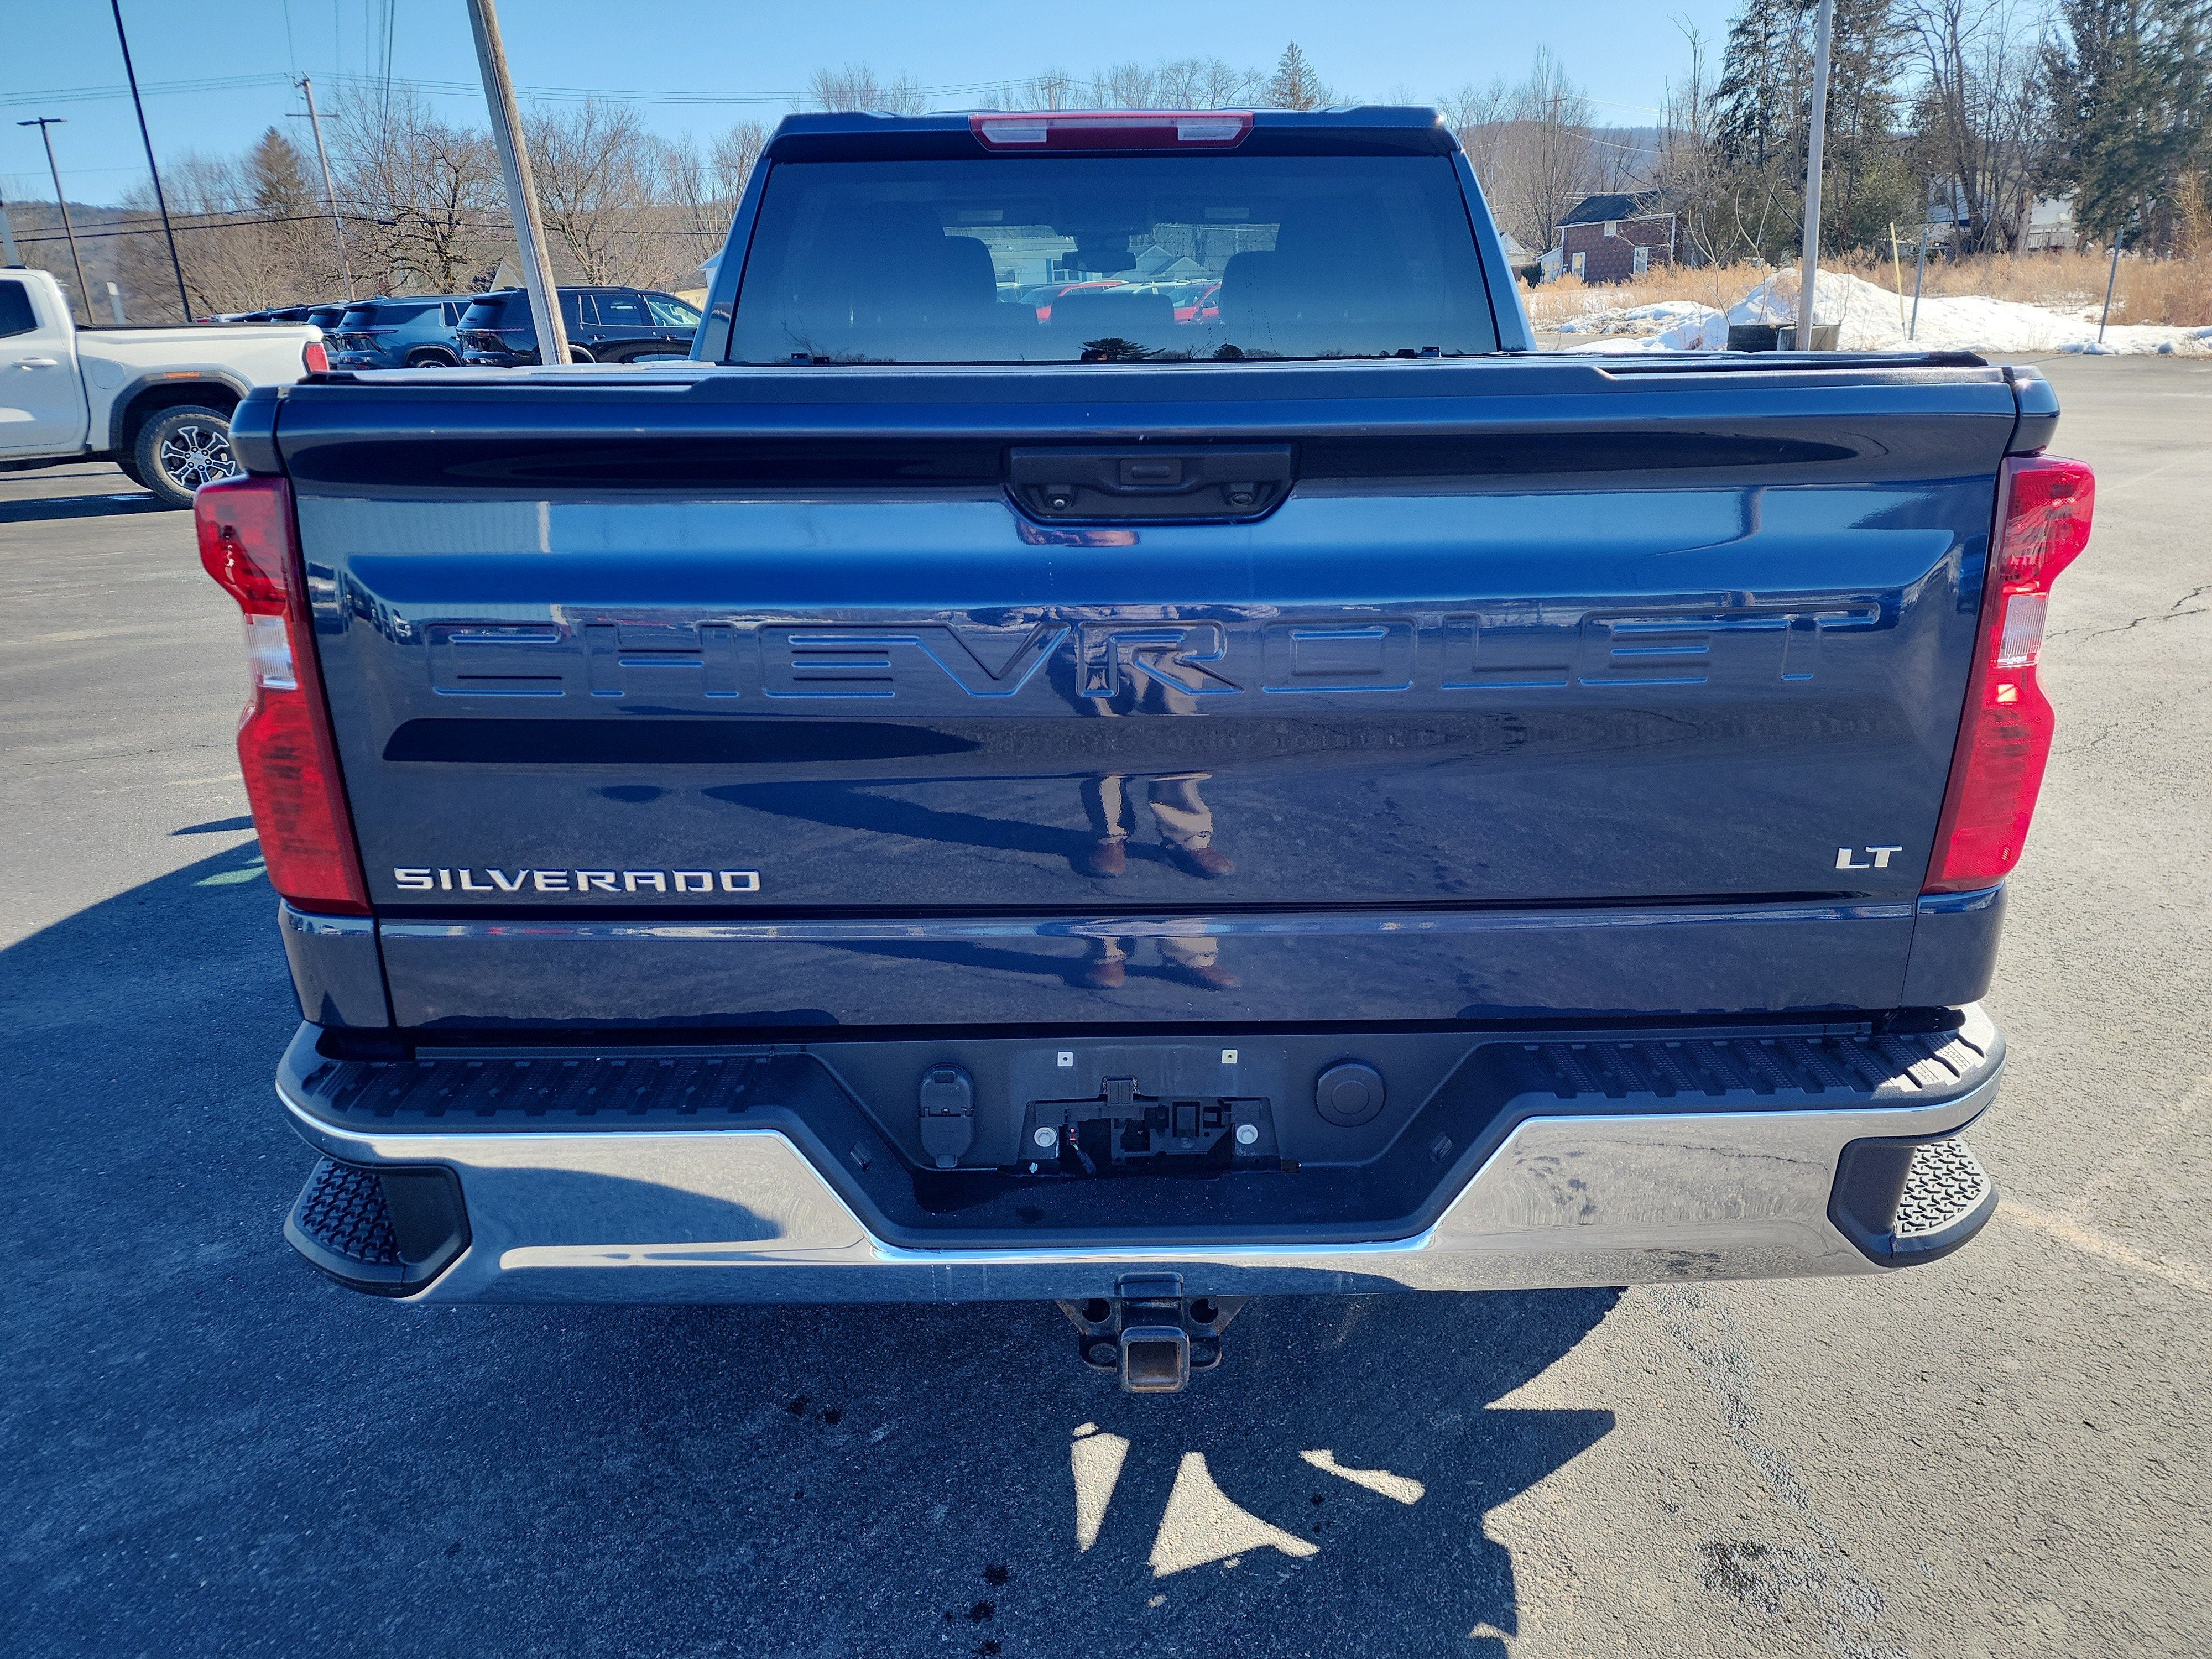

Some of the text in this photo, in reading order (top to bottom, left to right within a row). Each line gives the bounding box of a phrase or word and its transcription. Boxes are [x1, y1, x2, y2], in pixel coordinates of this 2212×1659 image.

[425, 602, 1880, 698] CHEVROLET
[1835, 844, 1902, 869] LT
[393, 868, 761, 892] SILVERADO
